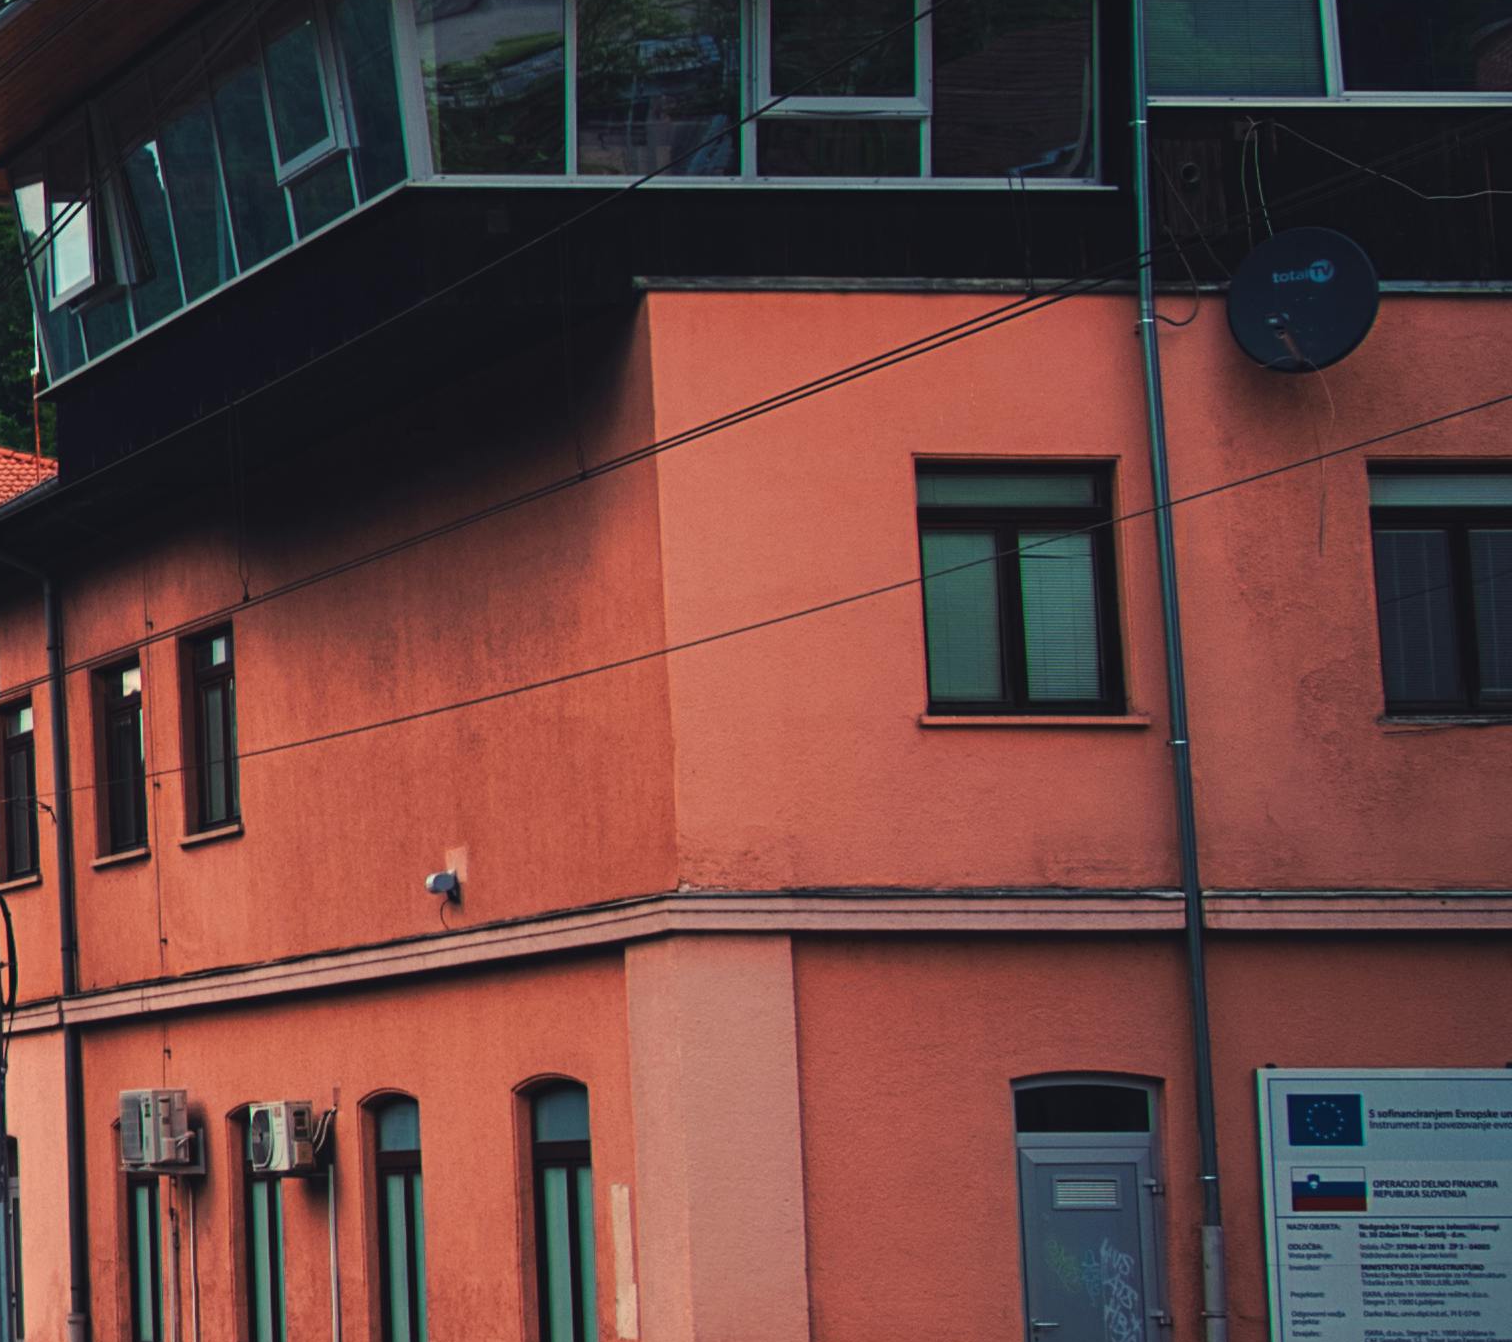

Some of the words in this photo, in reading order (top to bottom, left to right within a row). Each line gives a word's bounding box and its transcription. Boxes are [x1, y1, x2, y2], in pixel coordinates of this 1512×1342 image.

[1368, 1109, 1375, 1118] S
[1377, 1108, 1454, 1120] sofinanciranjem
[1455, 1109, 1499, 1120] Evropske
[1369, 1120, 1420, 1129] Instrument
[1434, 1122, 1492, 1131] povezovanje
[1421, 1179, 1451, 1189] DELNO
[1452, 1179, 1499, 1189] FINANCIRA
[1373, 1189, 1420, 1198] REPUBLIKA
[1421, 1189, 1467, 1198] SLOVENIJA
